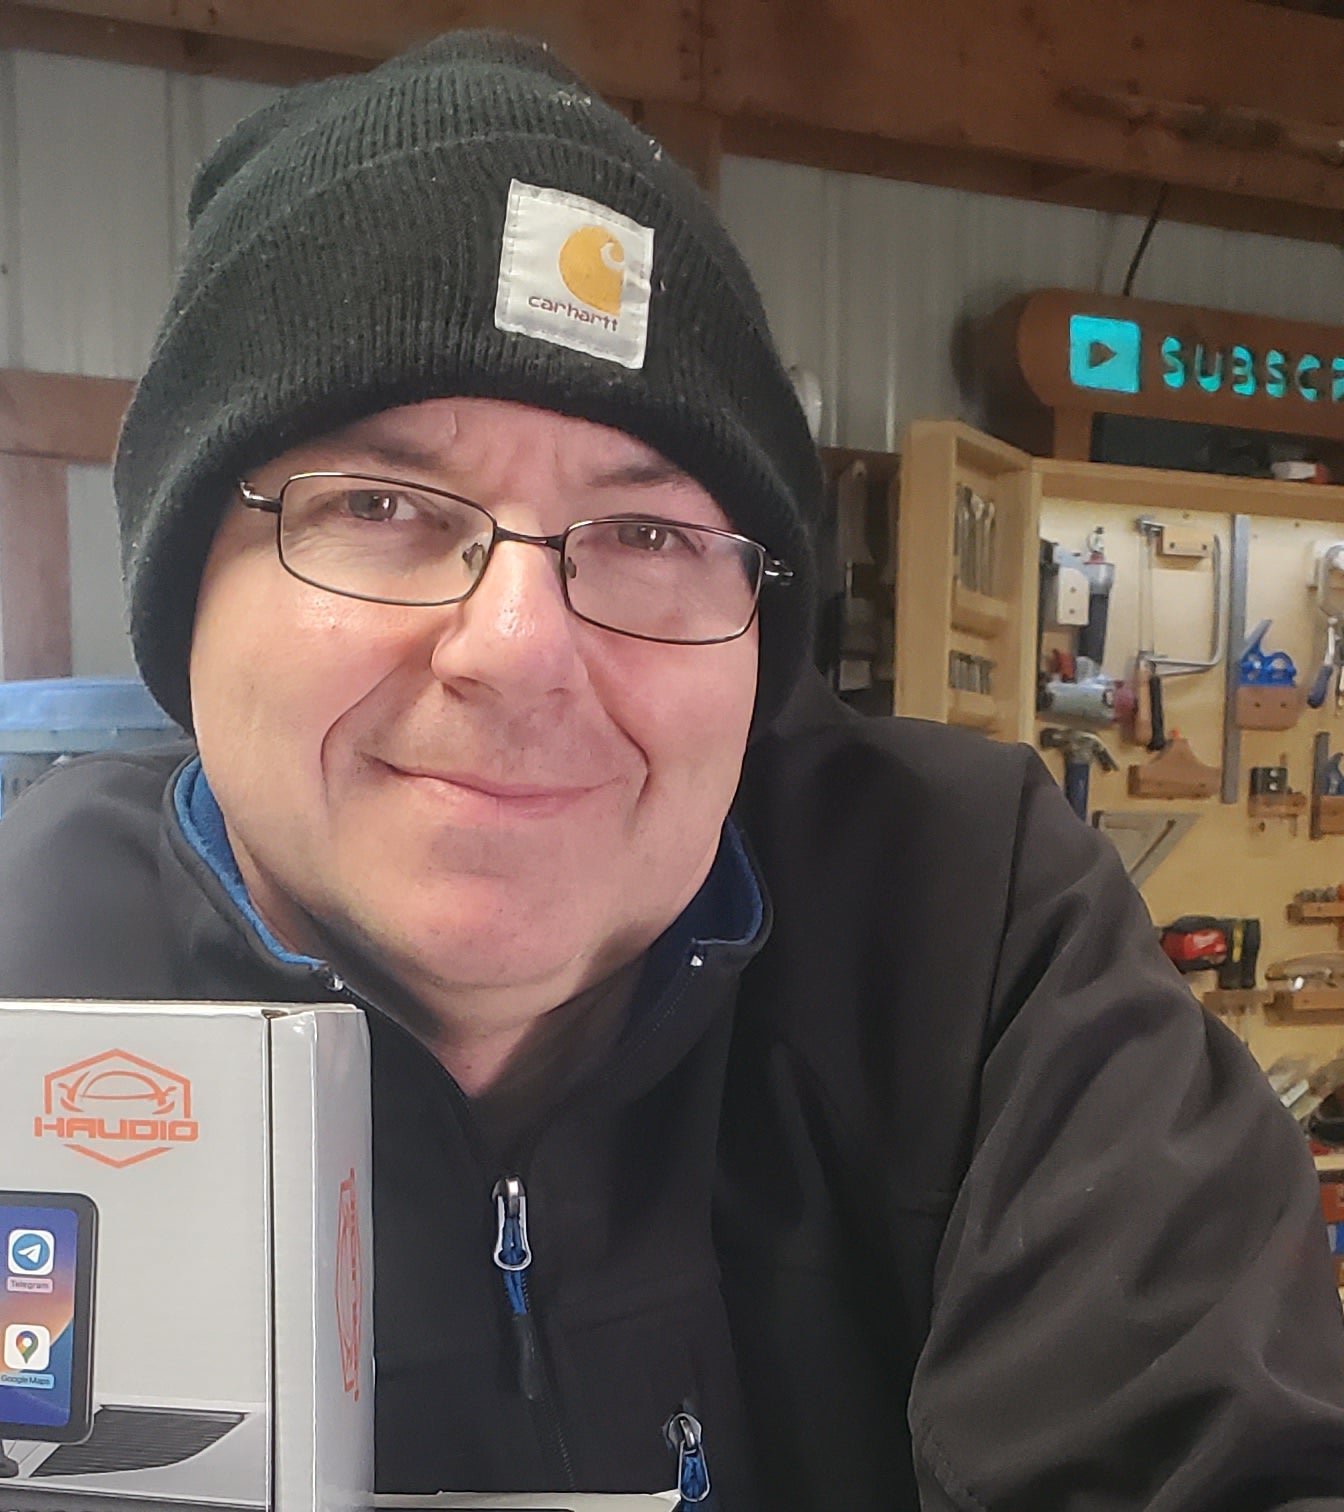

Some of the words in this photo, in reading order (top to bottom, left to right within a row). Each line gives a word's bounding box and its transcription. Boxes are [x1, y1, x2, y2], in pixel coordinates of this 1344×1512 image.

[528, 295, 619, 332] carhartt
[33, 1114, 199, 1142] HAUDIO
[10, 1279, 49, 1290] Telegram
